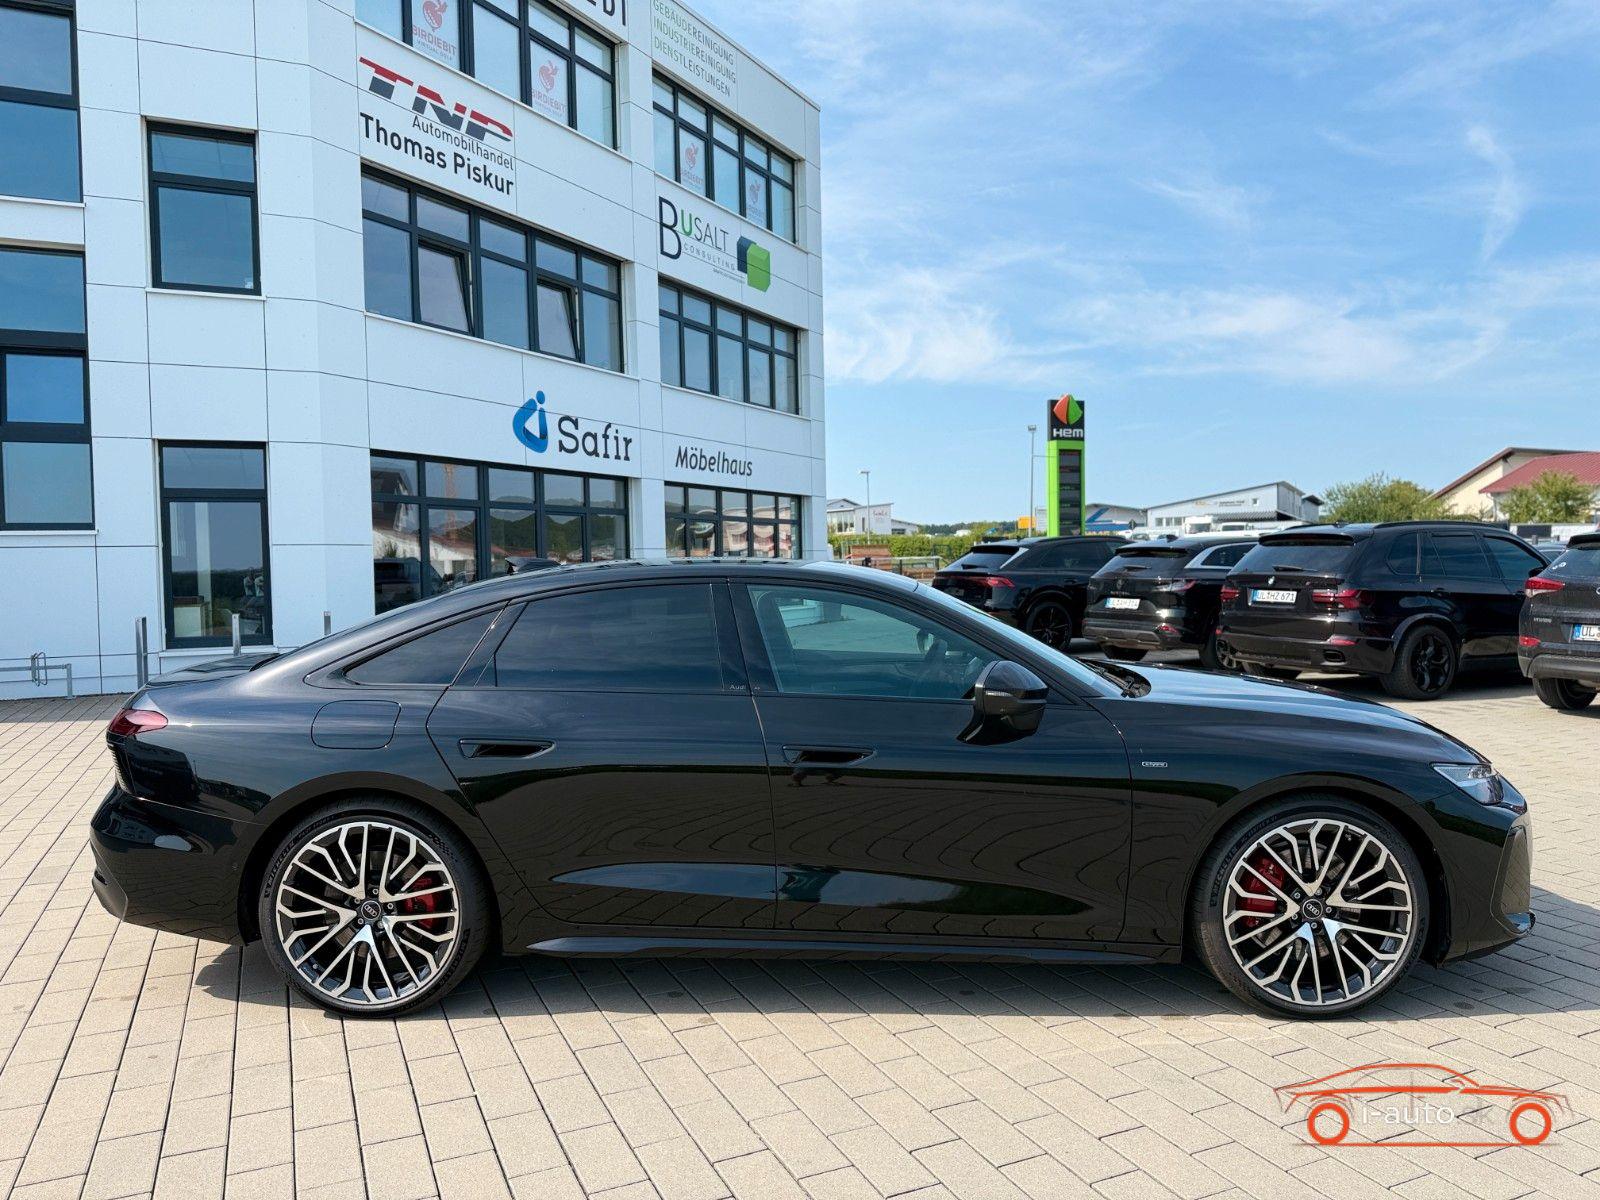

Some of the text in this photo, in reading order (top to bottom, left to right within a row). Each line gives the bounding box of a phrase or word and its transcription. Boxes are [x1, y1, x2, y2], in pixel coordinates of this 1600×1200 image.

[653, 15, 737, 84] INDUSTRIEREINIGUNG
[654, 35, 731, 97] DIENSTLEISTUNGEN
[359, 56, 513, 142] TNP
[360, 112, 514, 195] Thomas Piskur
[412, 115, 514, 171] Automobilhandel
[658, 195, 729, 260] BUSALT
[683, 243, 736, 271] CONSULTING
[557, 415, 633, 462] Safir
[675, 445, 753, 477] Möbelhaus
[1581, 626, 1595, 637] UL
